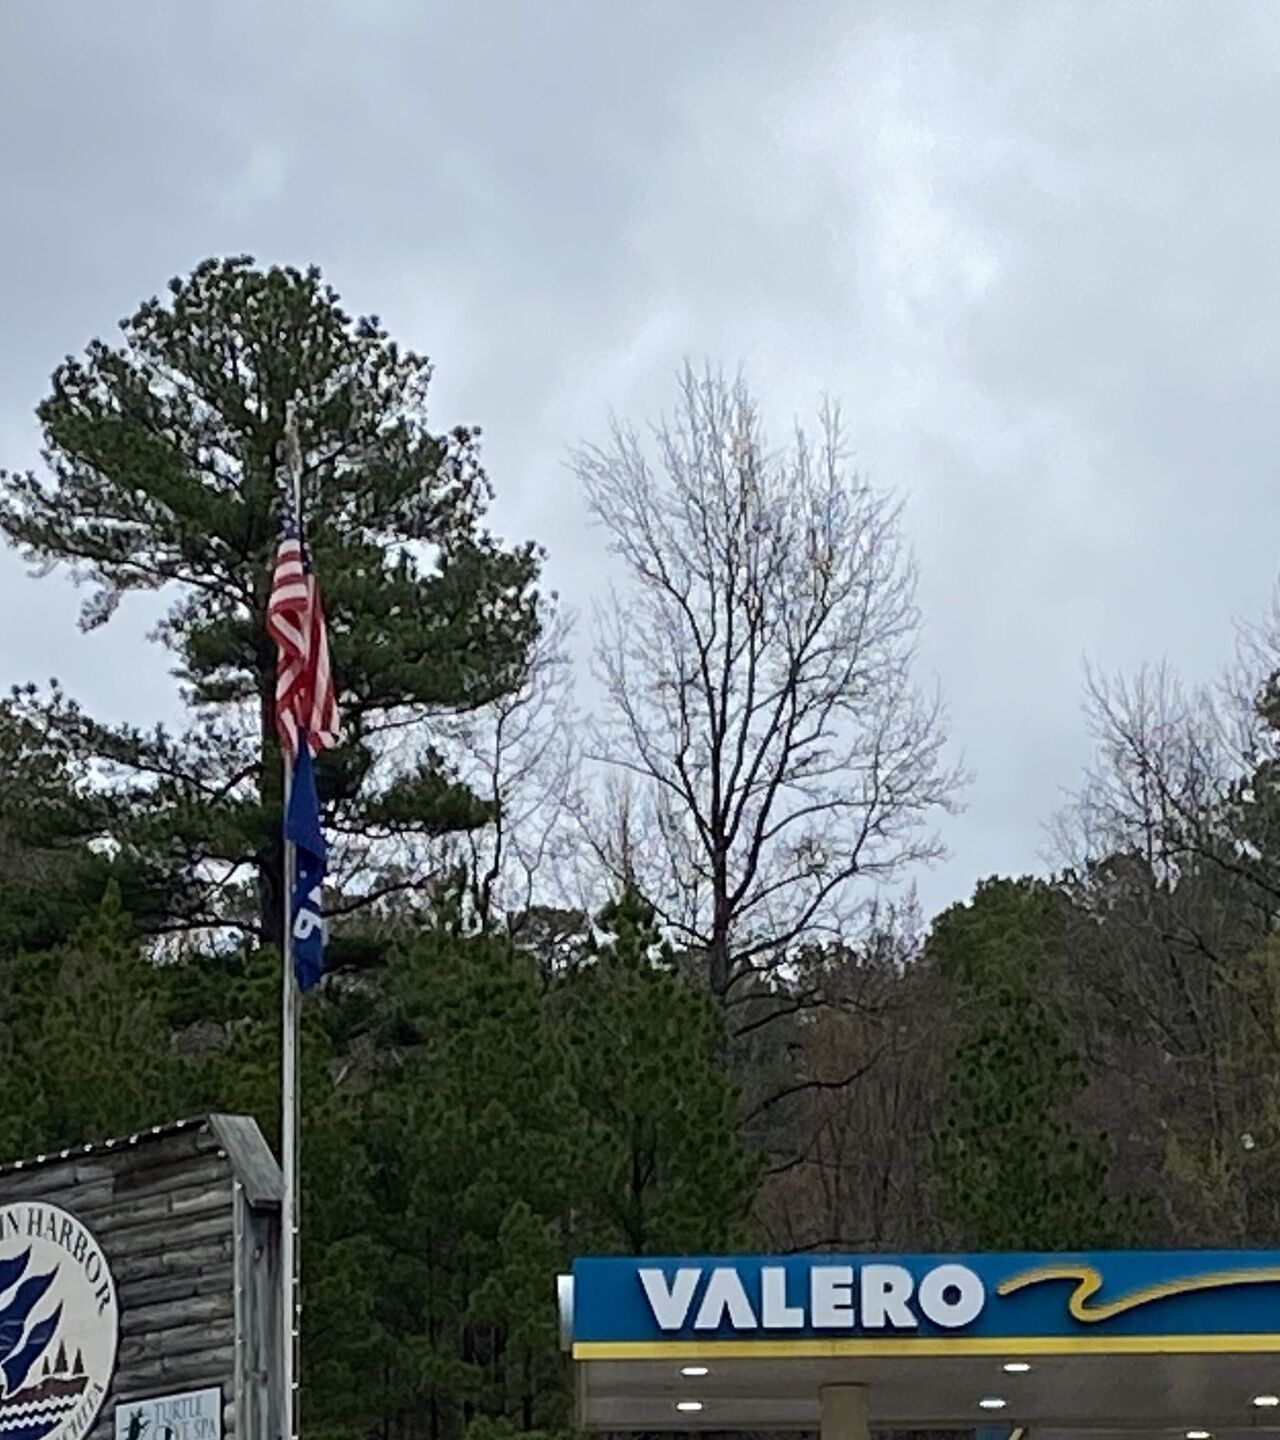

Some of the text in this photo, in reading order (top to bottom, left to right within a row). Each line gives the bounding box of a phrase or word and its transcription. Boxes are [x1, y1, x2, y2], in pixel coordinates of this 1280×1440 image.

[26, 1207, 112, 1317] HARBOR
[638, 1264, 985, 1330] VALERO
[193, 1416, 218, 1440] SPA
